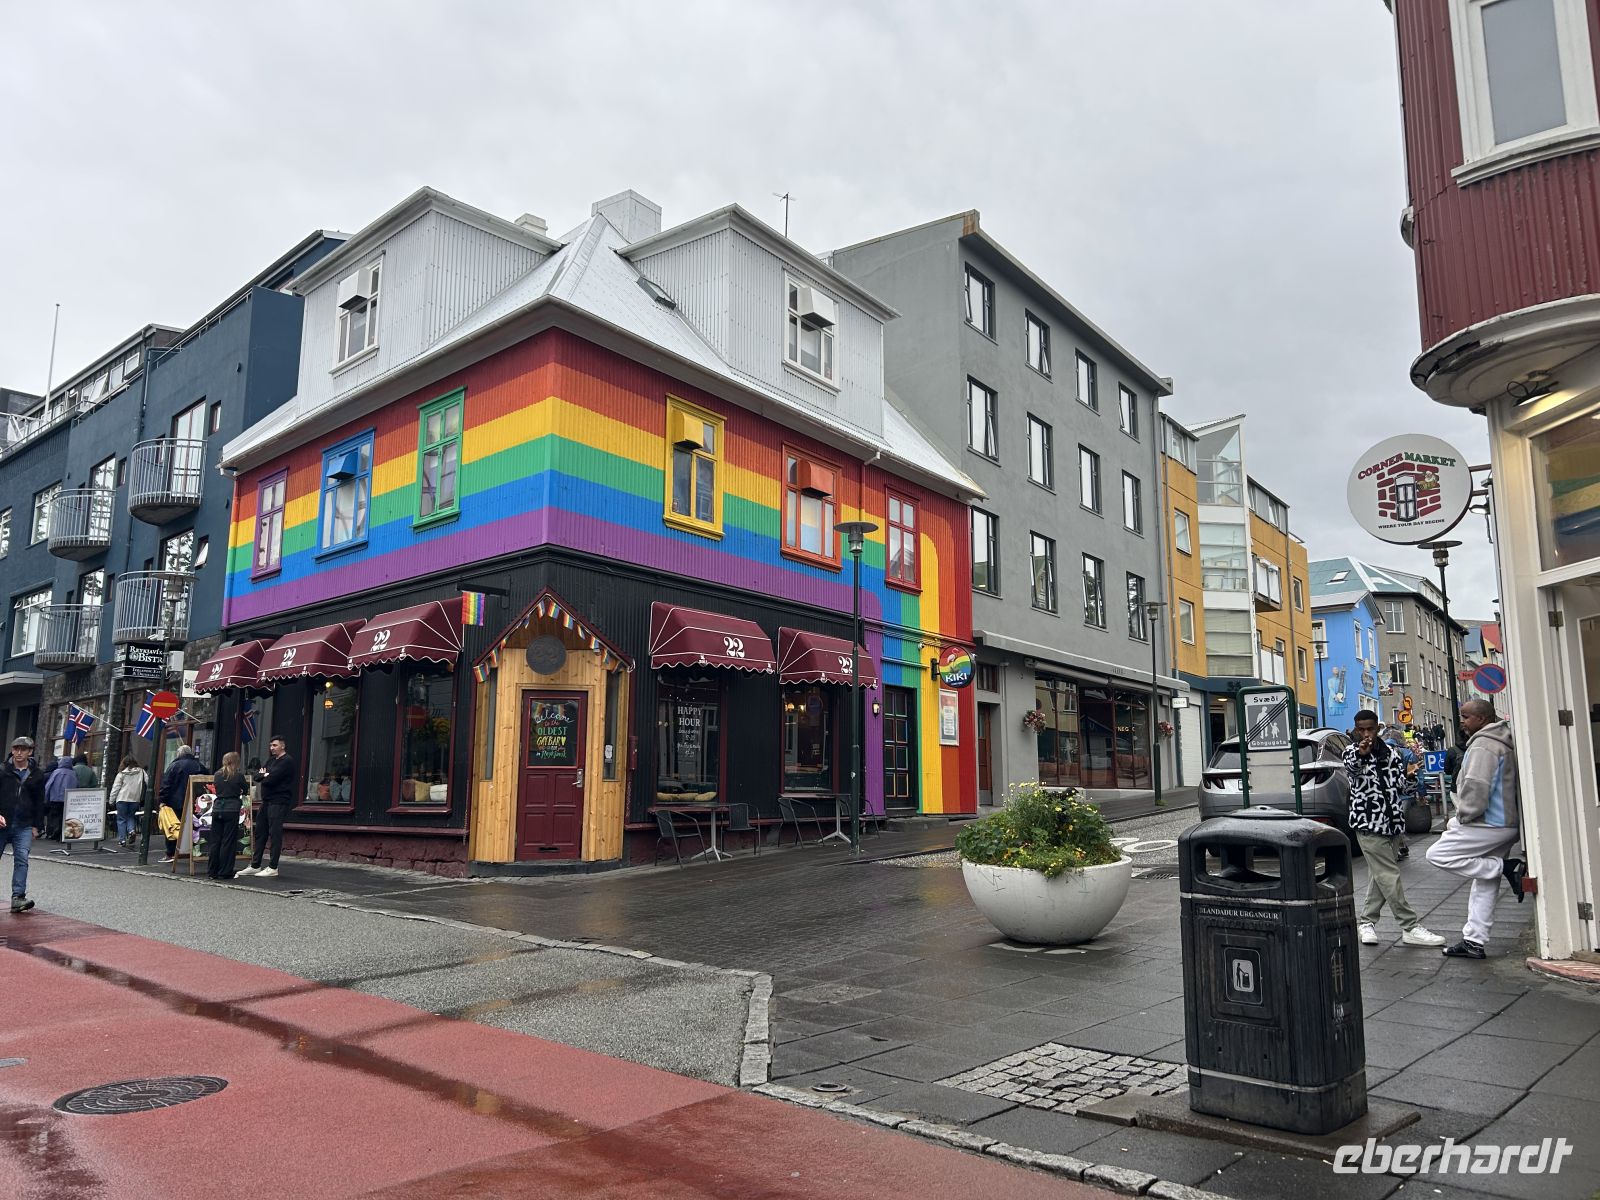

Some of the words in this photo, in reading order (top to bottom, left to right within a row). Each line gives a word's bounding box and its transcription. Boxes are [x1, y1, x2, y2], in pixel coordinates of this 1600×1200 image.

[1357, 452, 1404, 480] CORNER
[1404, 451, 1456, 467] MARKET
[370, 629, 391, 652] 22
[723, 636, 745, 658] 22
[138, 653, 163, 663] BISTR
[279, 647, 297, 667] 22
[837, 655, 853, 674] 22
[210, 663, 224, 680] 22
[945, 672, 968, 683] KIKI
[677, 706, 702, 715] HAPPY
[679, 717, 701, 726] HOUR
[537, 726, 568, 736] OLDEST
[1427, 754, 1436, 770] P
